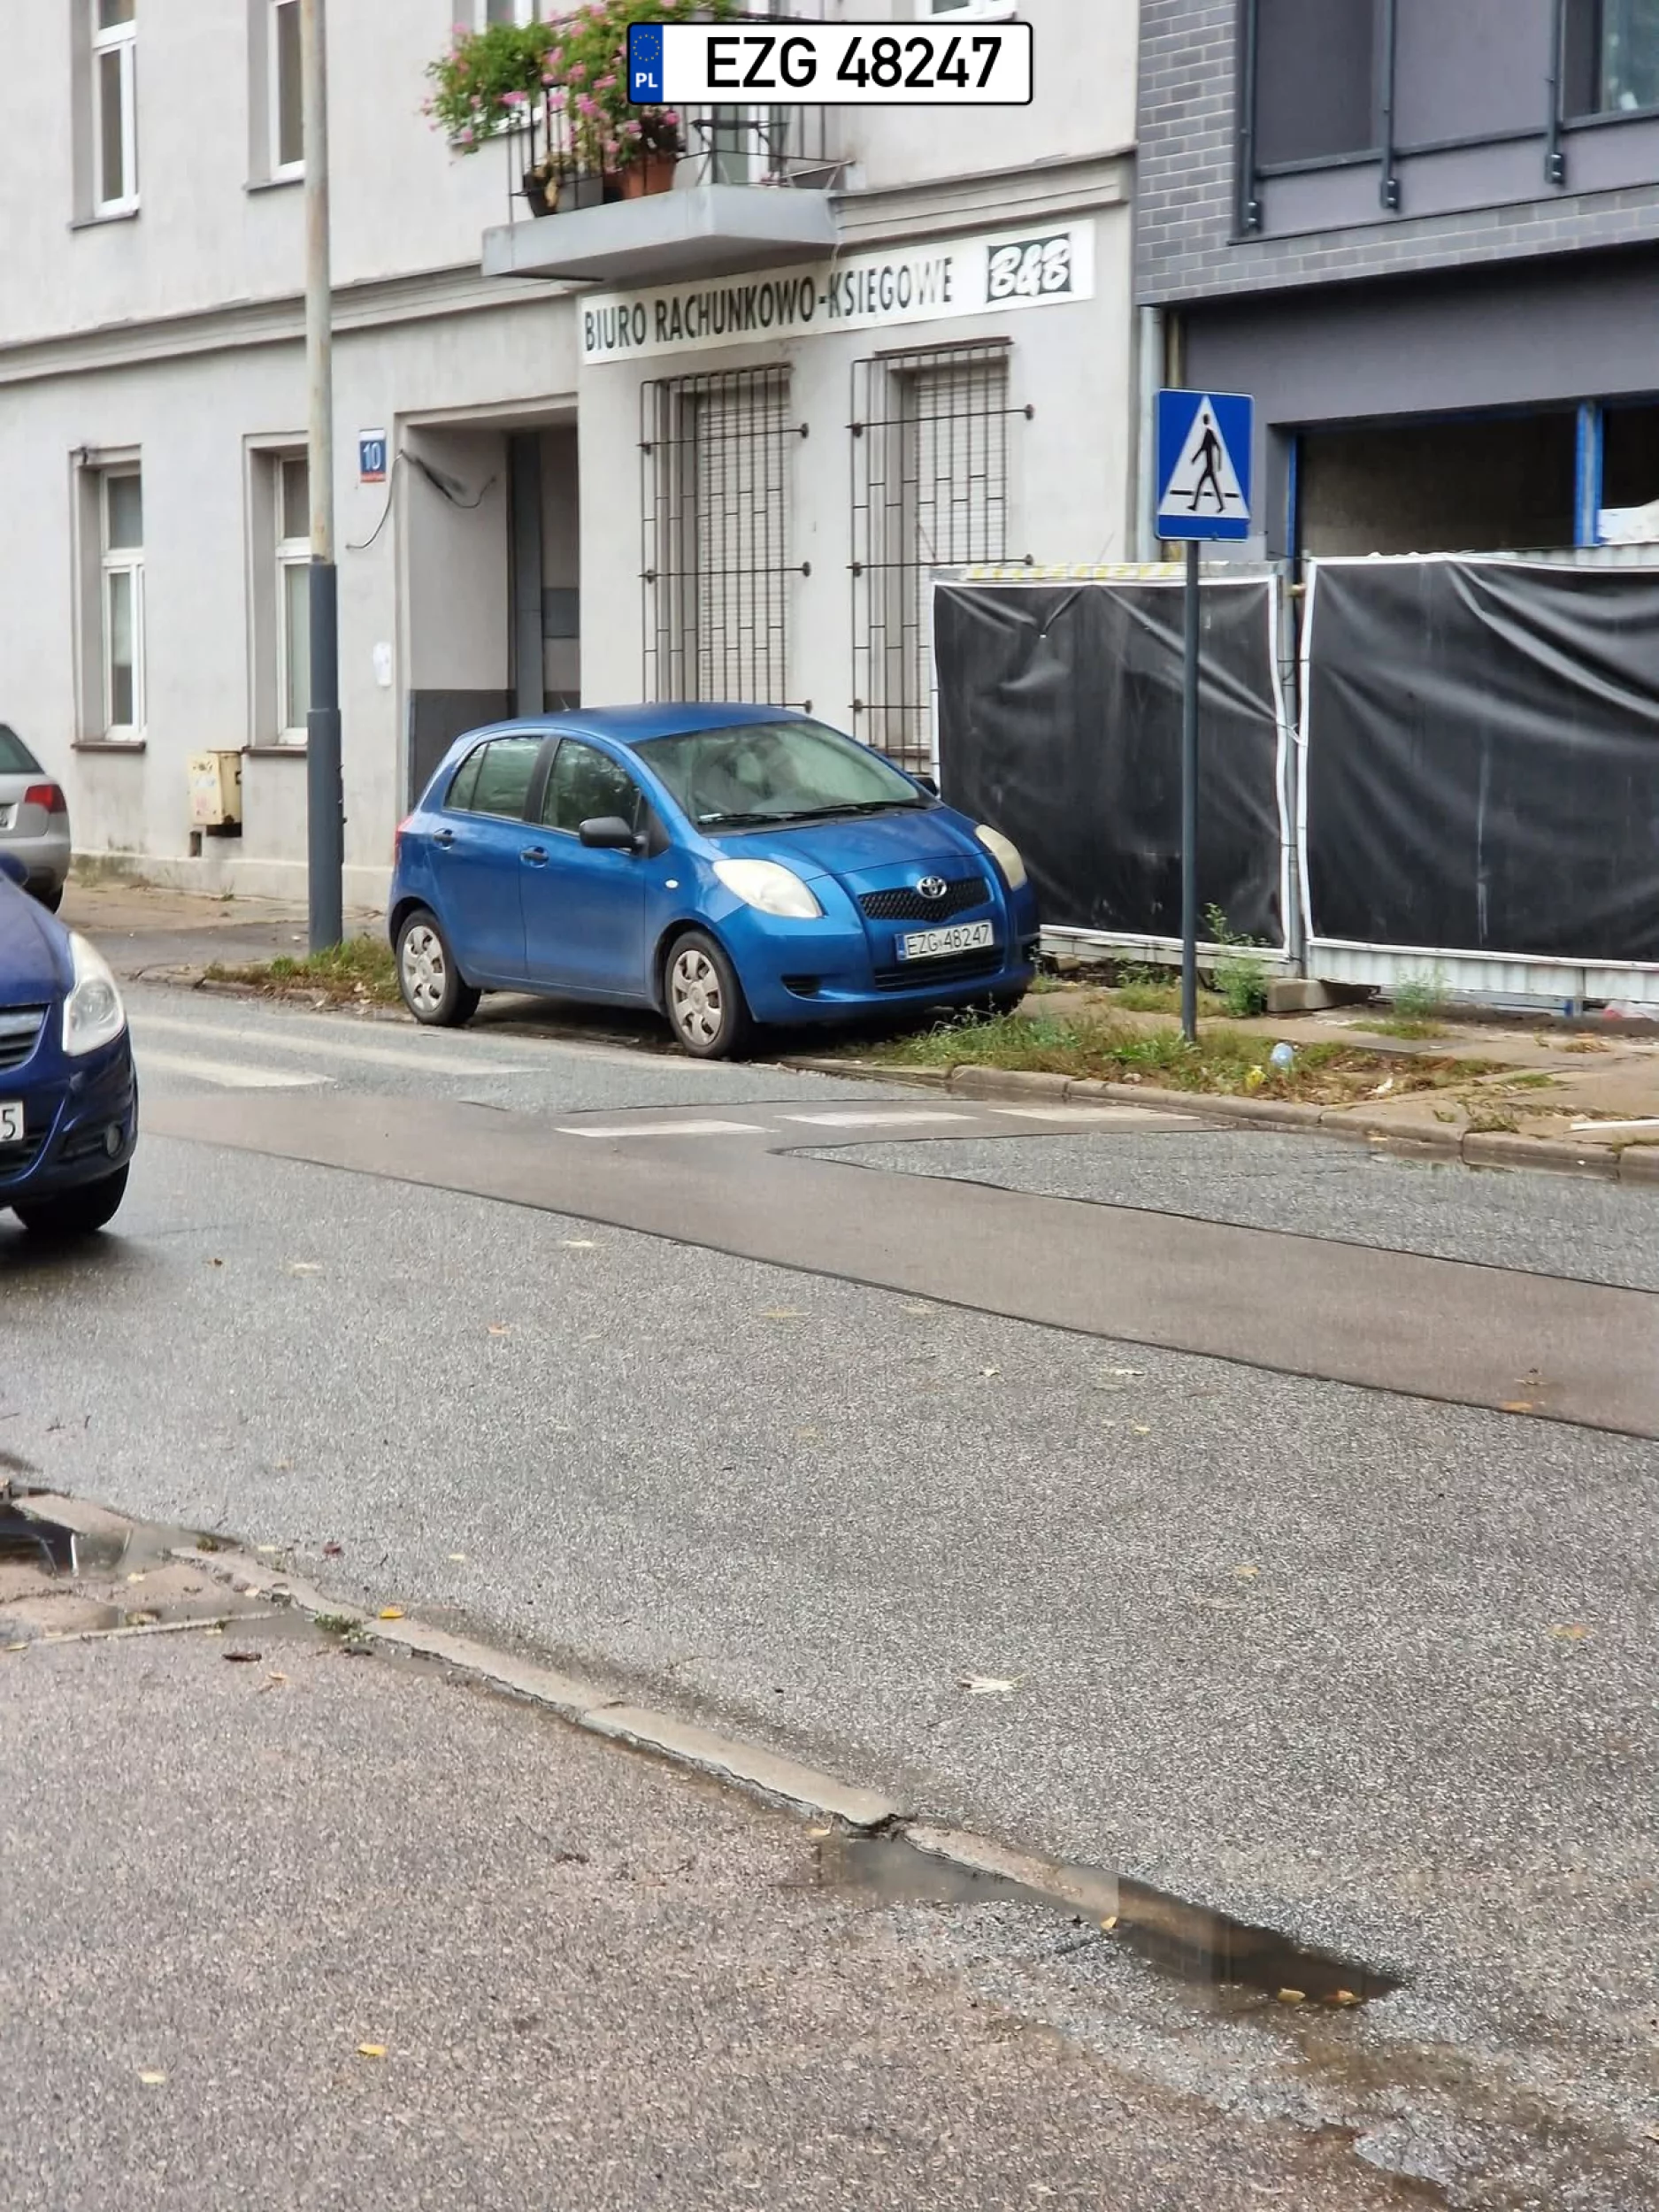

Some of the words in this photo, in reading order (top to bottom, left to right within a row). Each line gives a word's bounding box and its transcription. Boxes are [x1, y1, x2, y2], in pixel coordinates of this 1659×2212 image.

[584, 302, 647, 351] BIURO
[362, 442, 382, 471] 10
[906, 933, 938, 956] EZG
[943, 923, 990, 950] 48247
[2, 1108, 17, 1140] 5
